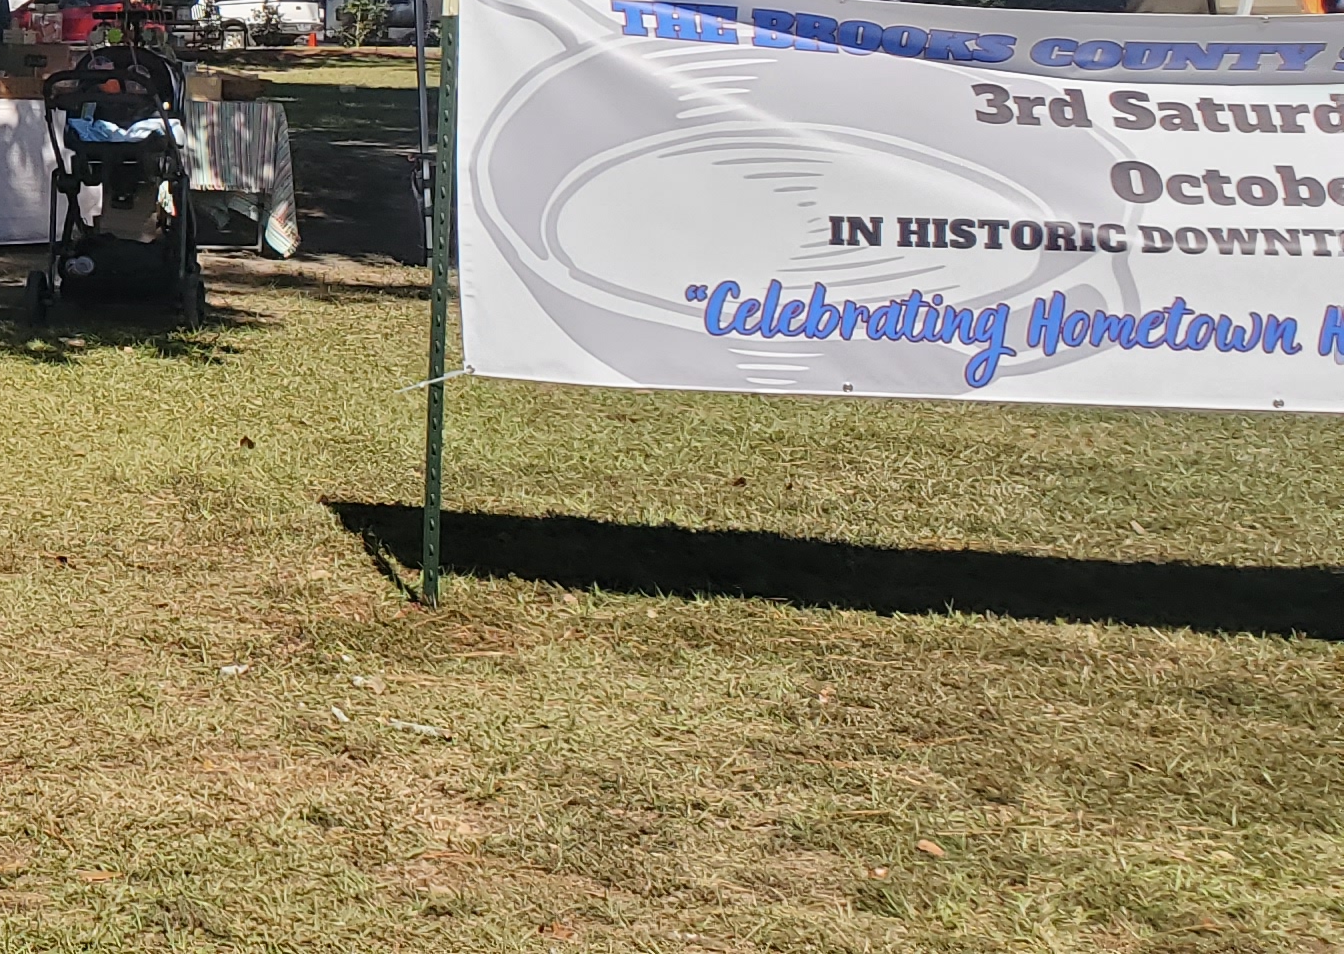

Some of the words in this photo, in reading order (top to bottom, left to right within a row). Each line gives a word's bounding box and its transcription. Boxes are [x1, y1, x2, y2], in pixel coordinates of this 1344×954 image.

[752, 8, 1018, 63] BROOKS
[1030, 37, 1328, 71] COUNTY
[971, 83, 1093, 128] 3rd
[828, 216, 884, 247] IN
[896, 217, 1127, 253] HISTORIC
[1137, 225, 1344, 257] DOWNT
[685, 279, 1017, 388] “Celebrating
[1028, 290, 1302, 357] Hometown
